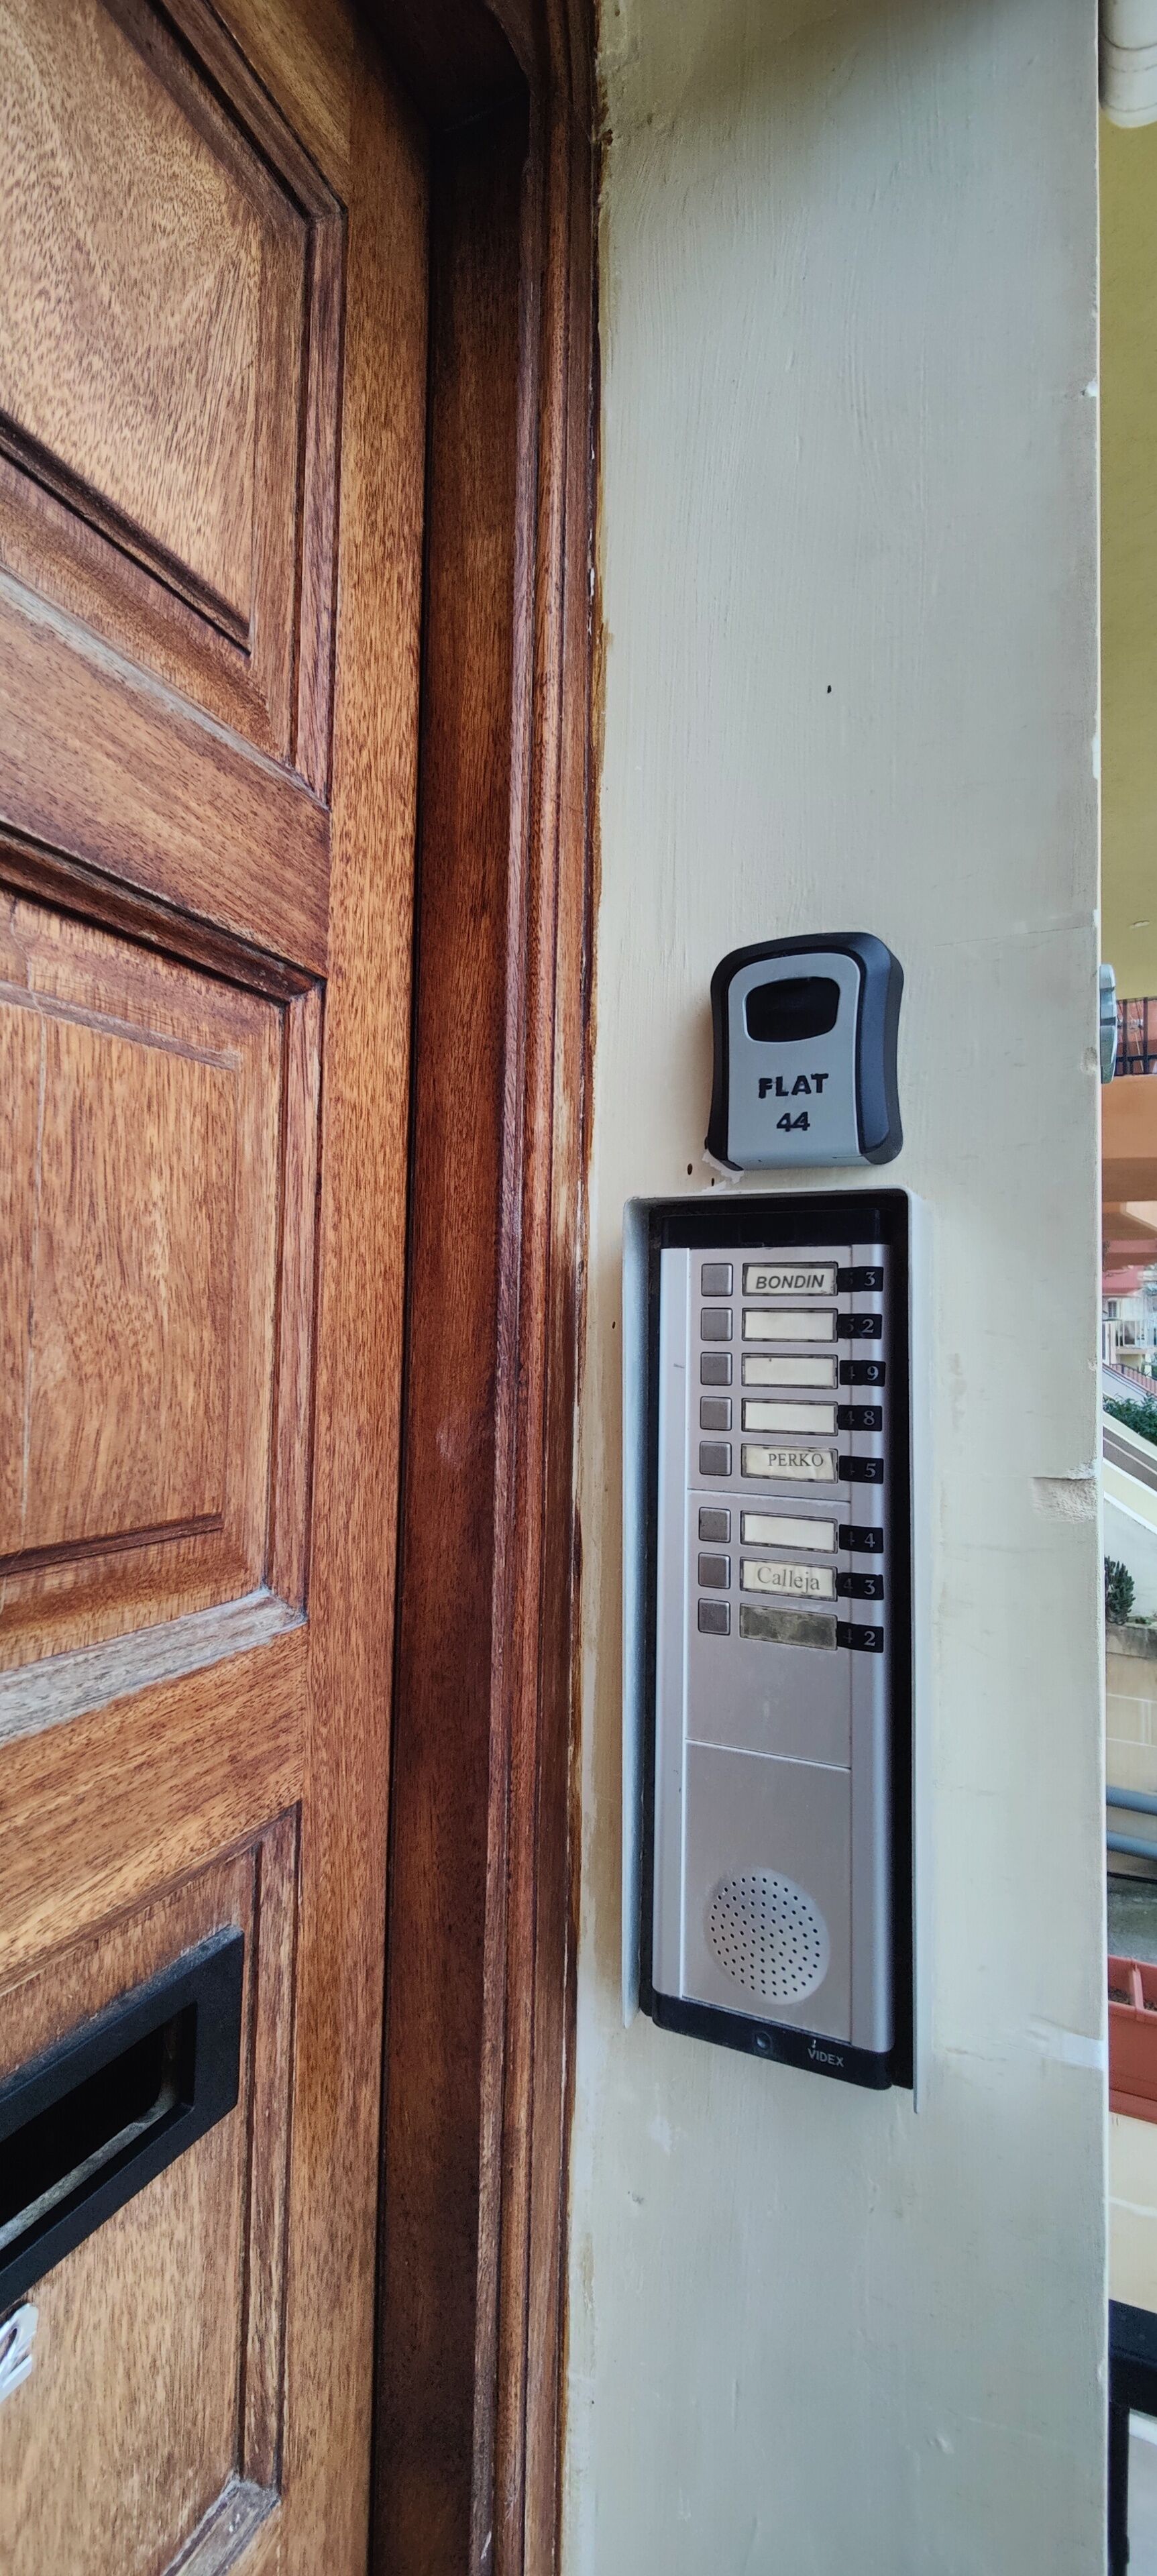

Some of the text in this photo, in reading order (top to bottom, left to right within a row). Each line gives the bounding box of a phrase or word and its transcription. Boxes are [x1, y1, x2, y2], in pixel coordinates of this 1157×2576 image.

[758, 1073, 829, 1099] FLAT
[776, 1111, 810, 1132] 44
[755, 1274, 825, 1289] BONDIN
[767, 1453, 824, 1467] PERKO
[757, 1566, 820, 1594] Calleja
[807, 2047, 845, 2068] VIDEX
